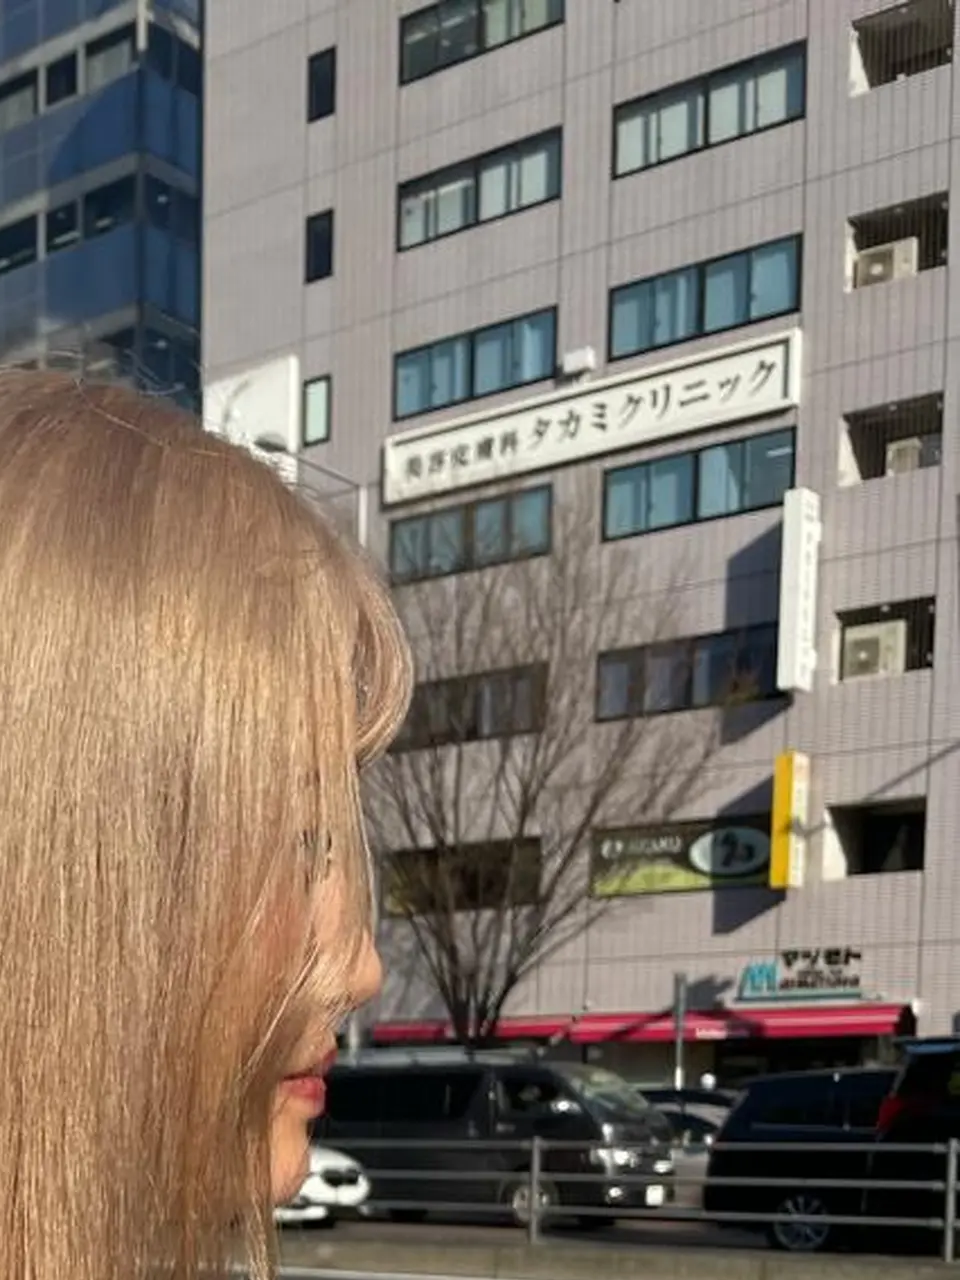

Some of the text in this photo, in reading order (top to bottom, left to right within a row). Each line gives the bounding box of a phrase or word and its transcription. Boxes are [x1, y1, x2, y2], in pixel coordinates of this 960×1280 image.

[526, 360, 776, 448] タカミクリニック
